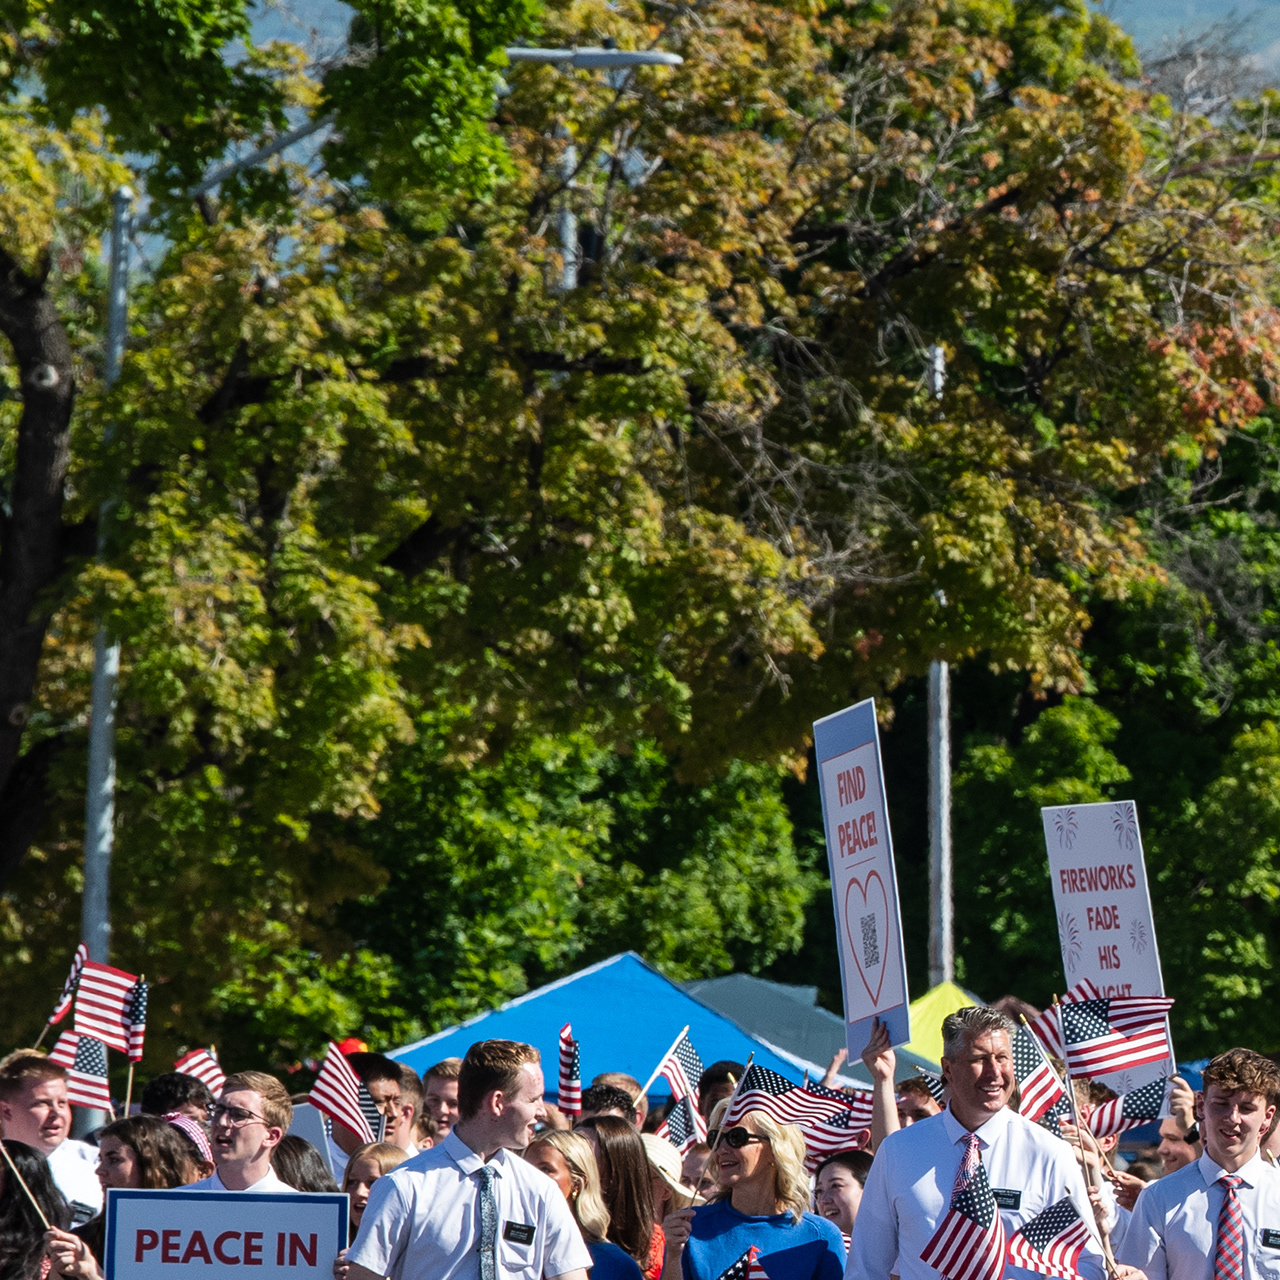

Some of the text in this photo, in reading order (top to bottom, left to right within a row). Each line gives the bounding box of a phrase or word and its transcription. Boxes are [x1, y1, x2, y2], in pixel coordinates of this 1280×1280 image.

[837, 765, 866, 808] FIND
[837, 811, 878, 859] PEACE!
[1059, 863, 1137, 894] FIREWORKS
[1086, 905, 1121, 931] FADE
[1098, 944, 1121, 970] HIS
[135, 1229, 318, 1266] PEACE IN
